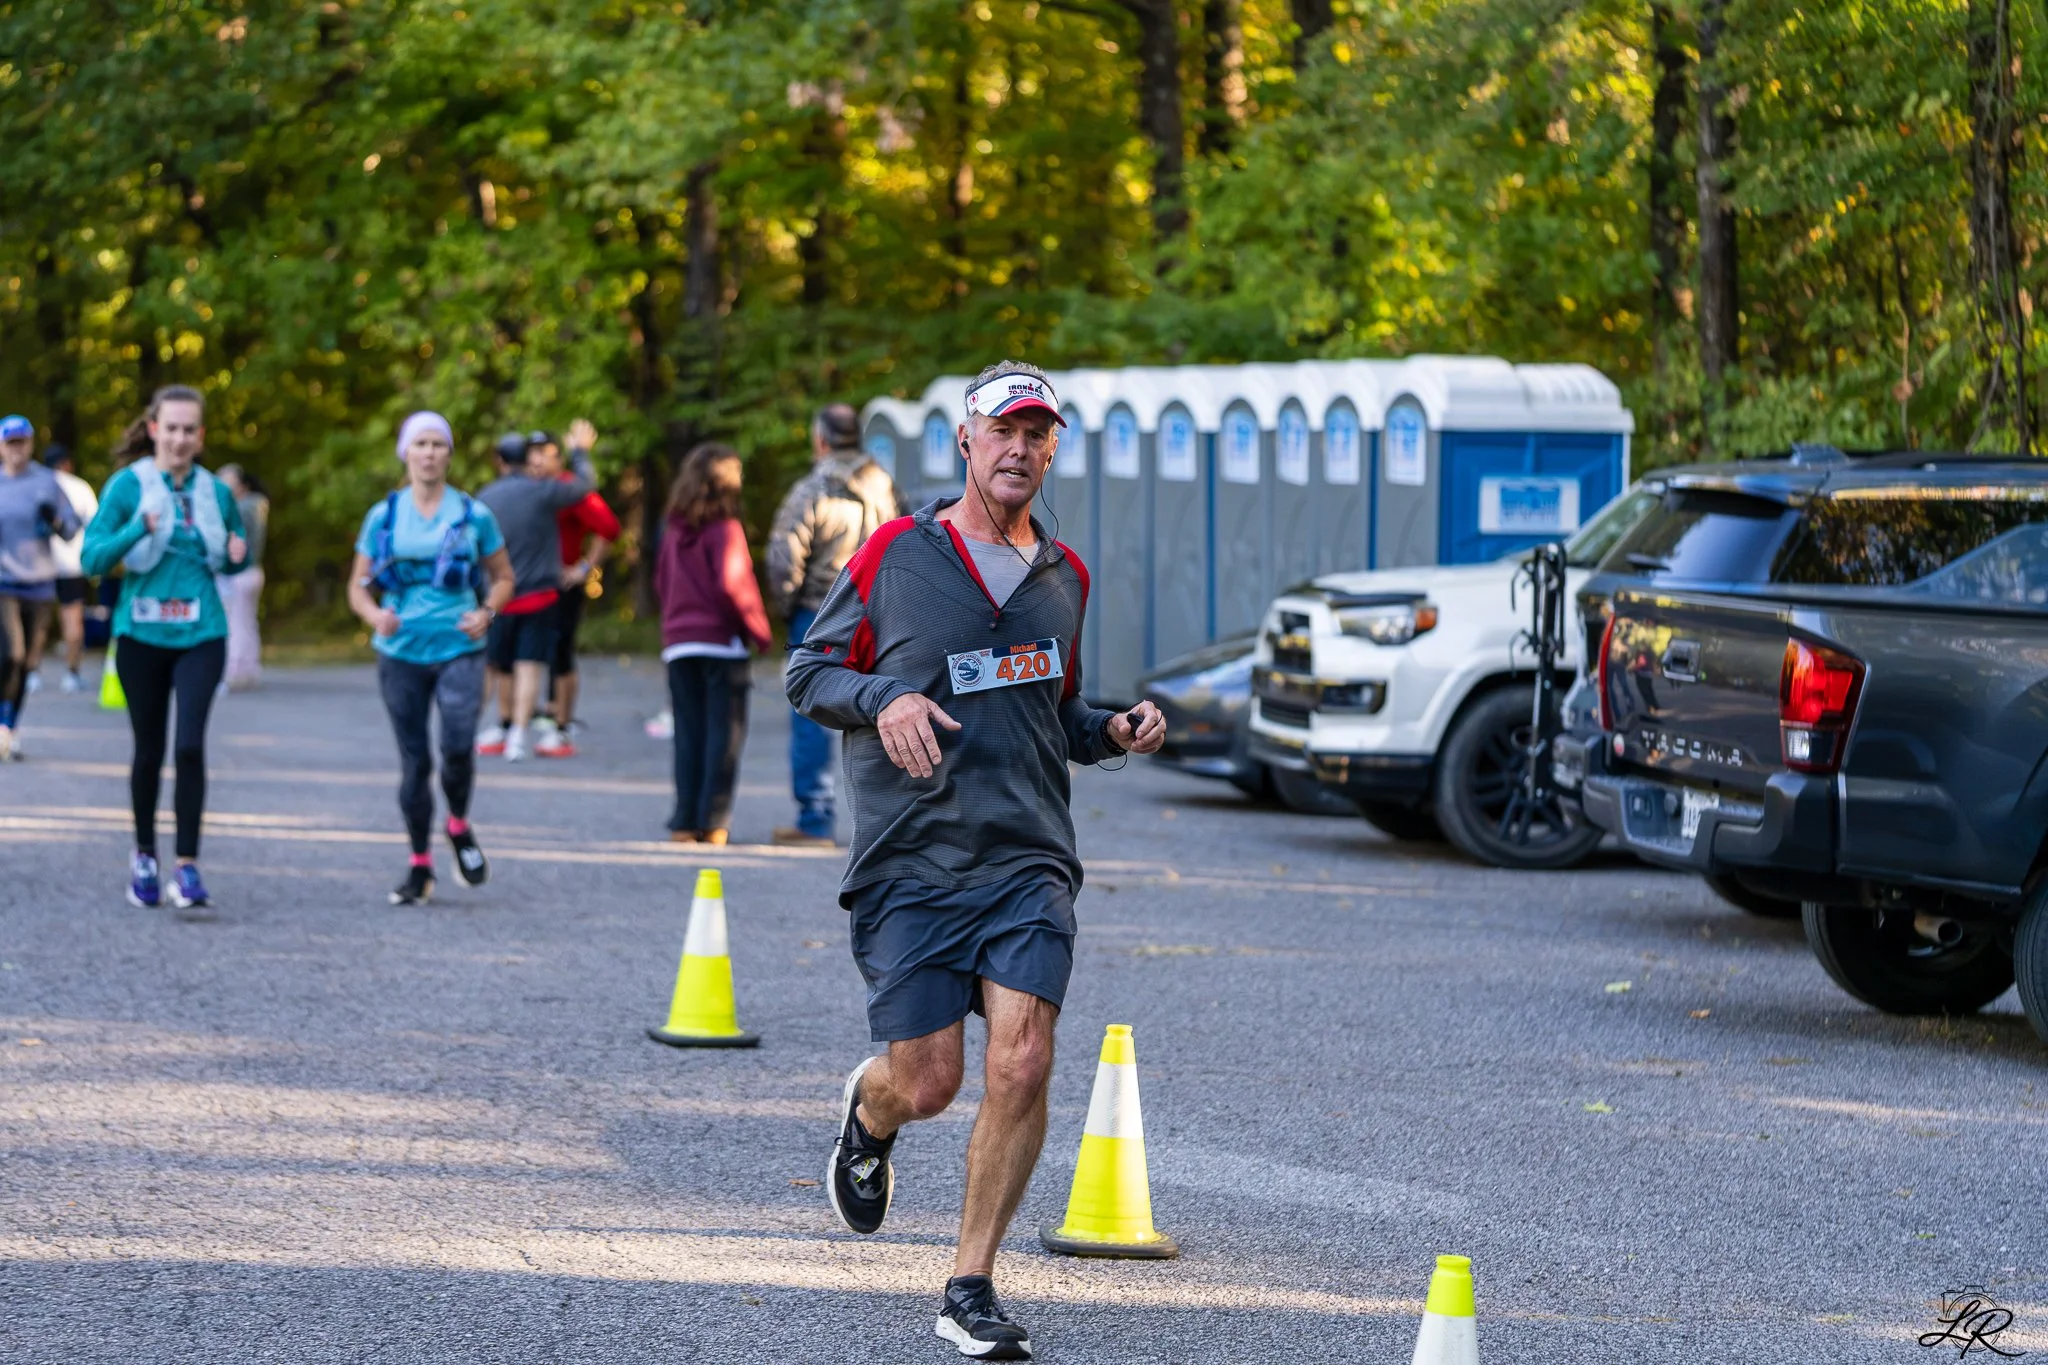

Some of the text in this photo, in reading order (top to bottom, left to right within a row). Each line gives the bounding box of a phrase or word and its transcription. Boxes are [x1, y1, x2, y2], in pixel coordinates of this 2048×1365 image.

[1010, 642, 1037, 654] Michael
[996, 652, 1051, 682] 420
[1641, 730, 1743, 767] TACOMA
